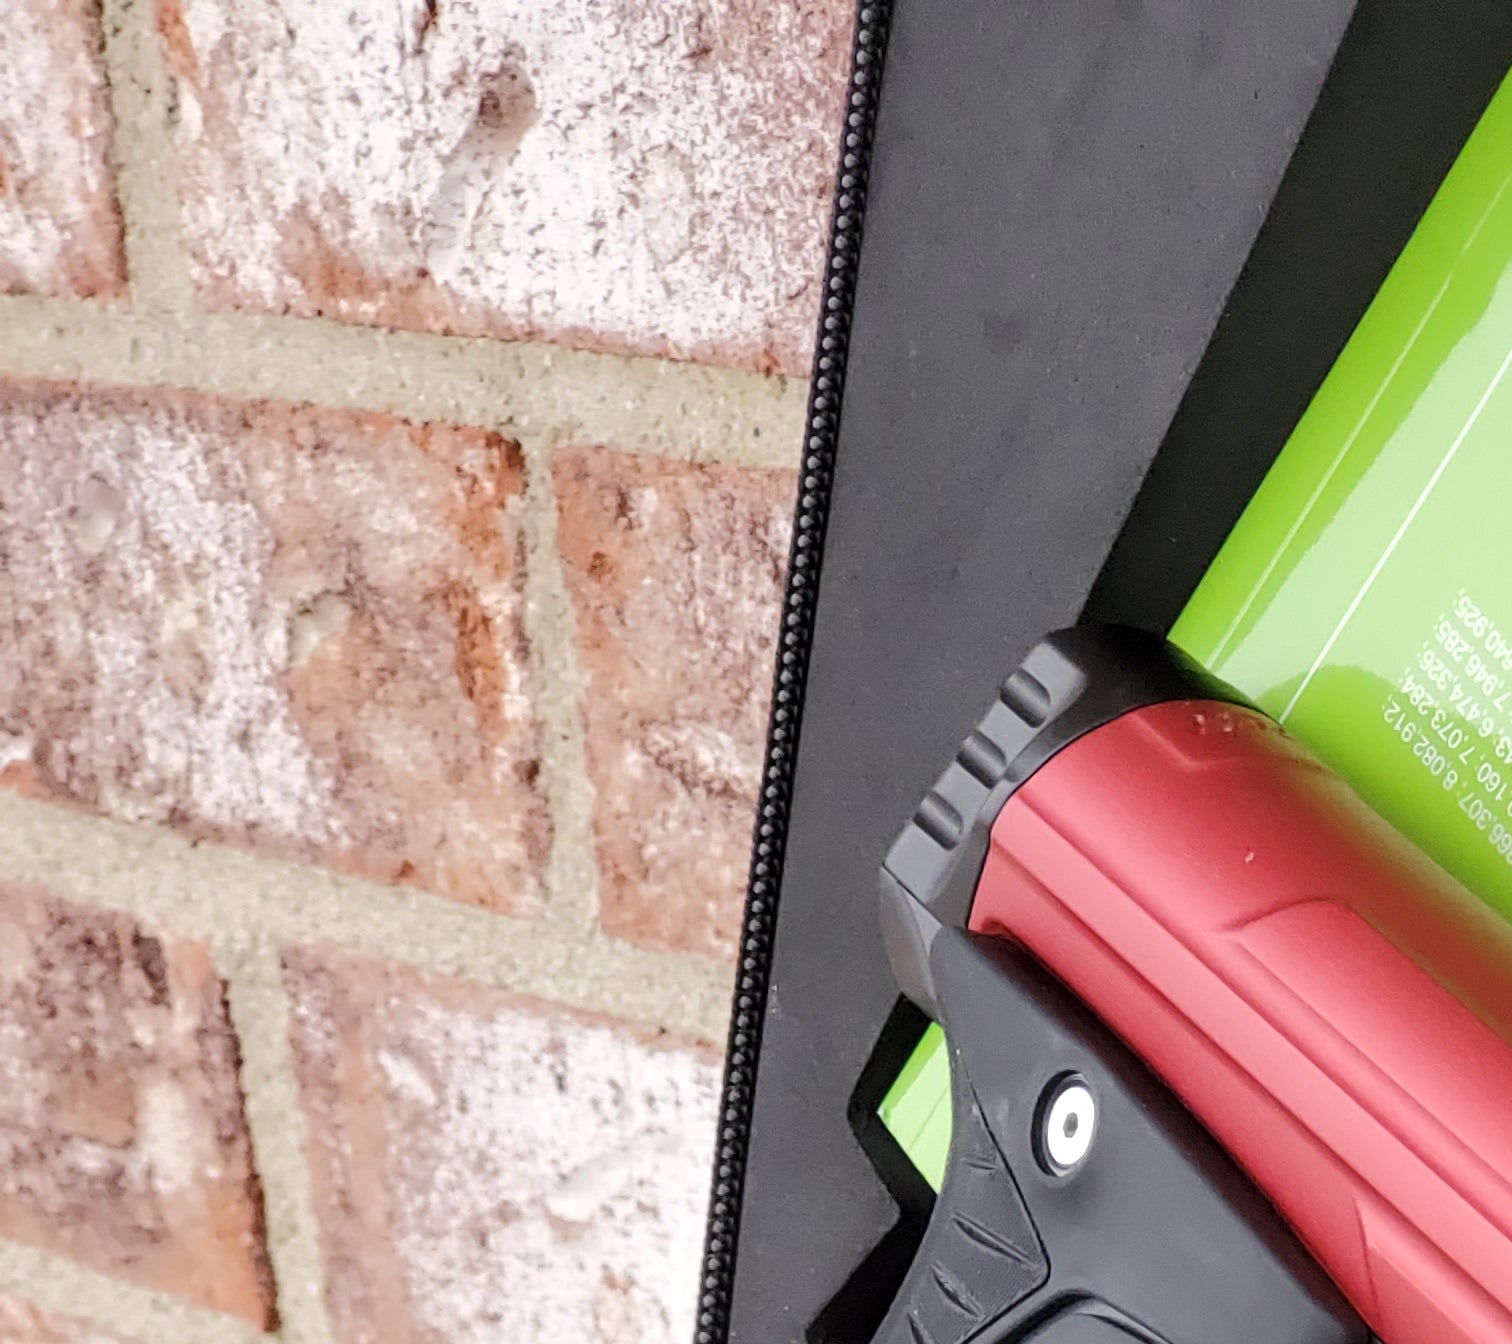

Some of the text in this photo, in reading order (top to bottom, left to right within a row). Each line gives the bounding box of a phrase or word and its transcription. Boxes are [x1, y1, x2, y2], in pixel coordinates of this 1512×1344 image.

[1417, 641, 1495, 738] 6,474,326;
[1433, 614, 1511, 712] 7,946,285;
[1383, 696, 1458, 790] 8,082,912;
[1400, 676, 1475, 765] 7,073,284;
